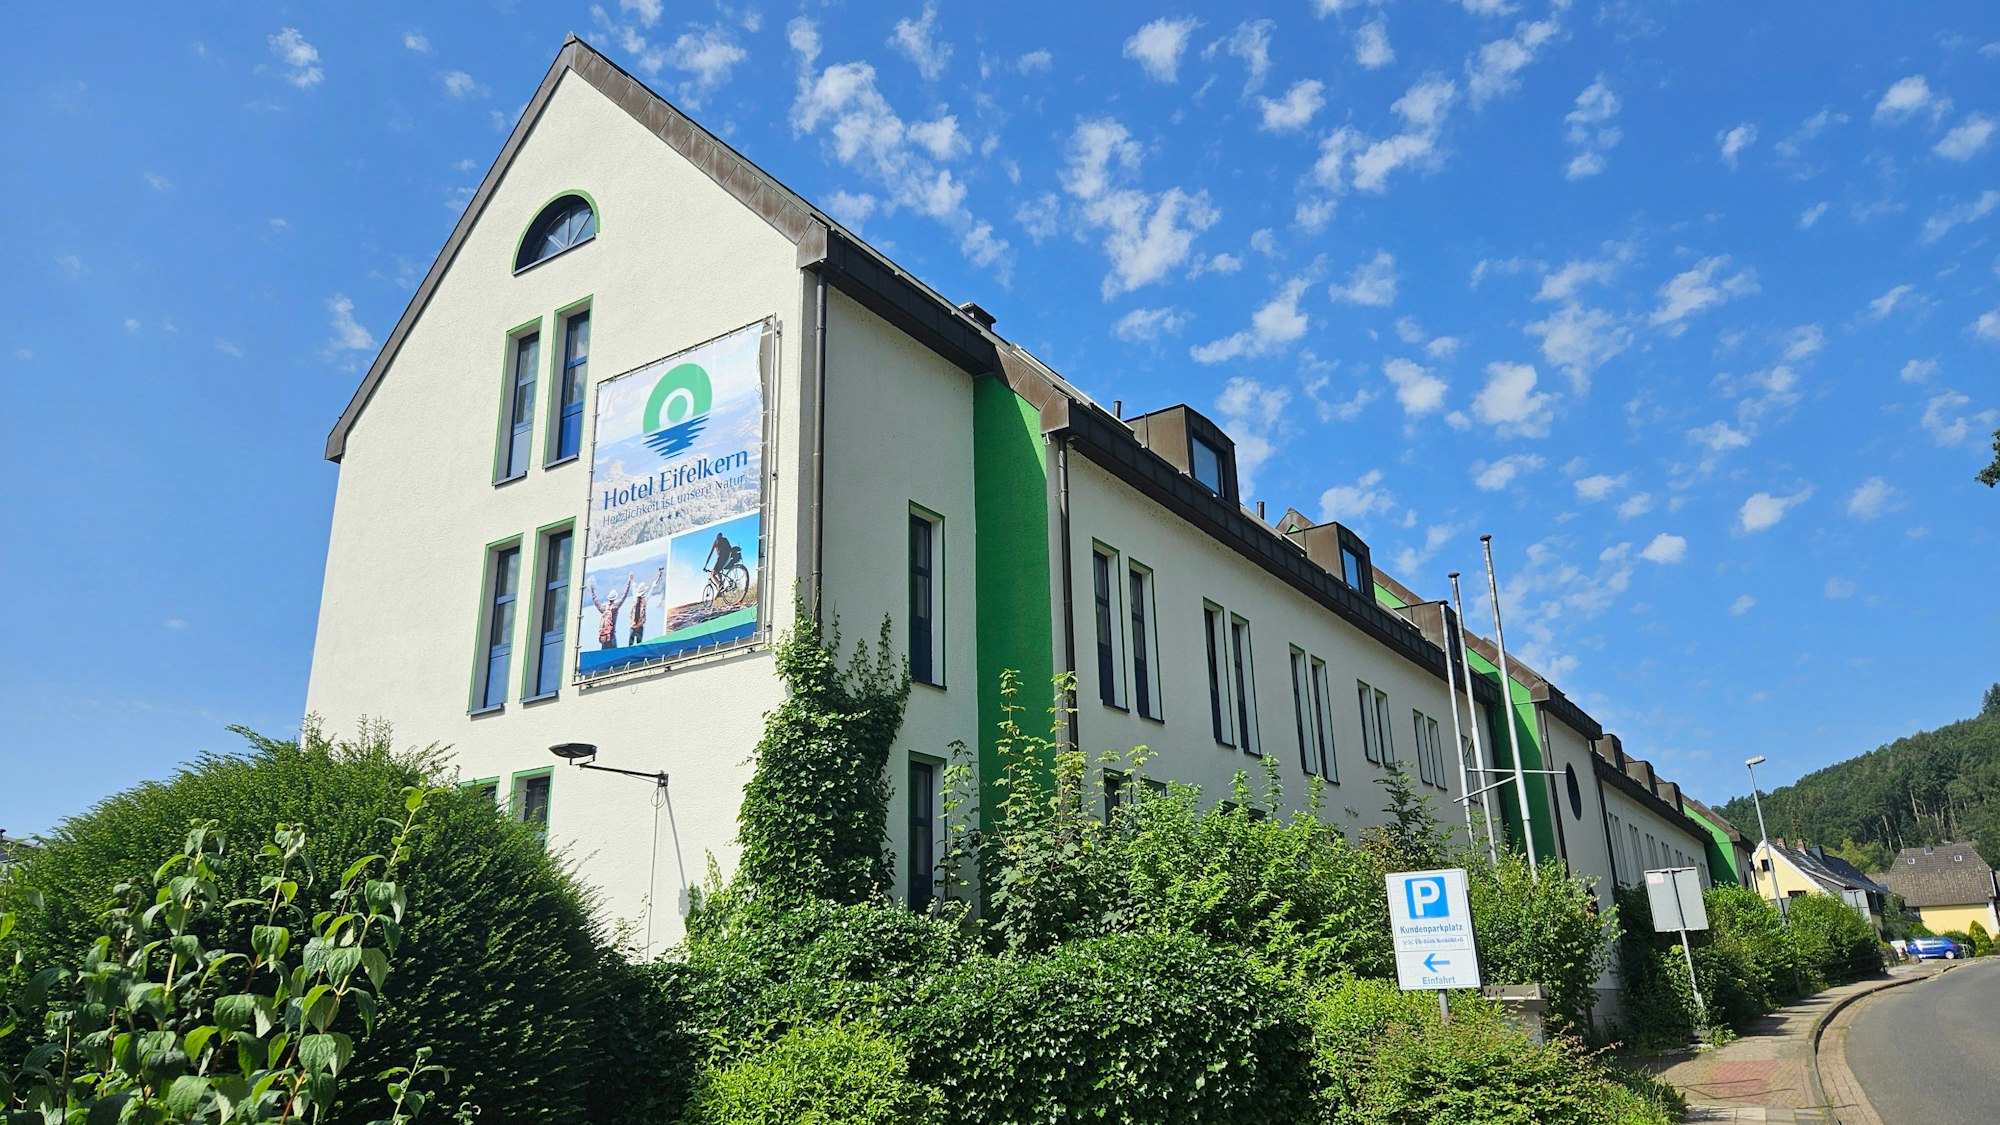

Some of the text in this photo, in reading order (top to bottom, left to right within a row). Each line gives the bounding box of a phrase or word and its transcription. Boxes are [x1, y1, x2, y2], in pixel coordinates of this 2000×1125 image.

[604, 450, 748, 510] Hotel Eifelkern
[602, 501, 659, 527] Herzlichkeit
[661, 498, 675, 510] ist
[677, 484, 712, 504] unsere
[1411, 880, 1440, 916] P
[1400, 924, 1463, 934] Kundenparkplatz
[1422, 976, 1456, 985] Einfahrt
